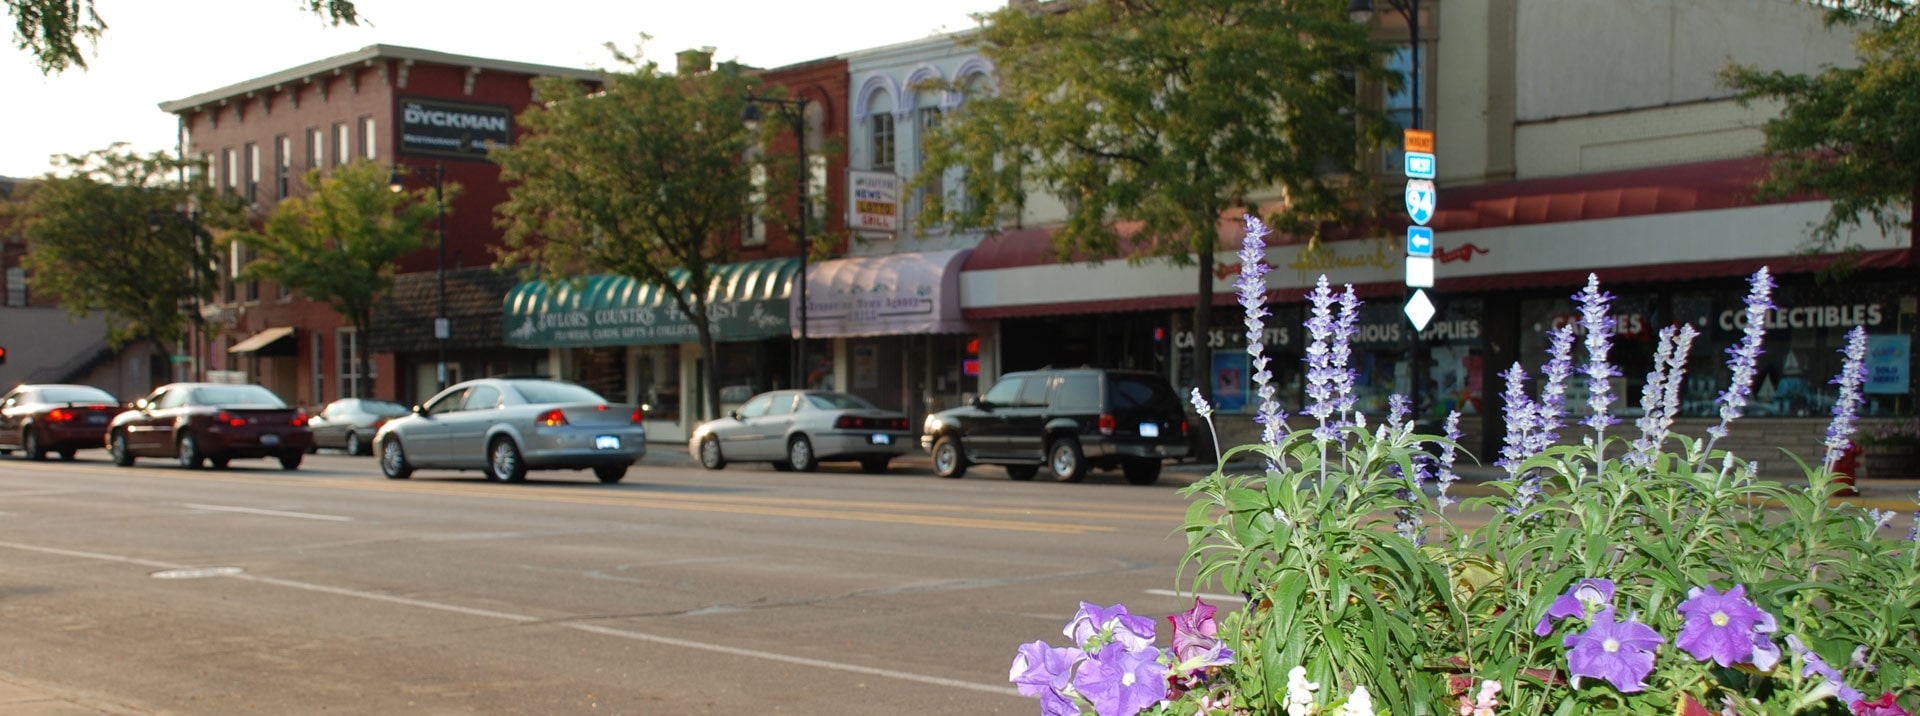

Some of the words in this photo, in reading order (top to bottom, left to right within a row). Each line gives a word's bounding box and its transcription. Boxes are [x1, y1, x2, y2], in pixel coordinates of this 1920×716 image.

[404, 109, 505, 131] DYCKMAN
[1409, 157, 1432, 174] WEST
[855, 189, 881, 199] NEWS
[1408, 190, 1432, 215] 94
[860, 202, 891, 214] LOTTO
[862, 216, 889, 227] GRILL
[594, 307, 656, 326] COUNTRY
[1719, 304, 1882, 331] COLECTIBLES
[1175, 331, 1226, 348] CADS
